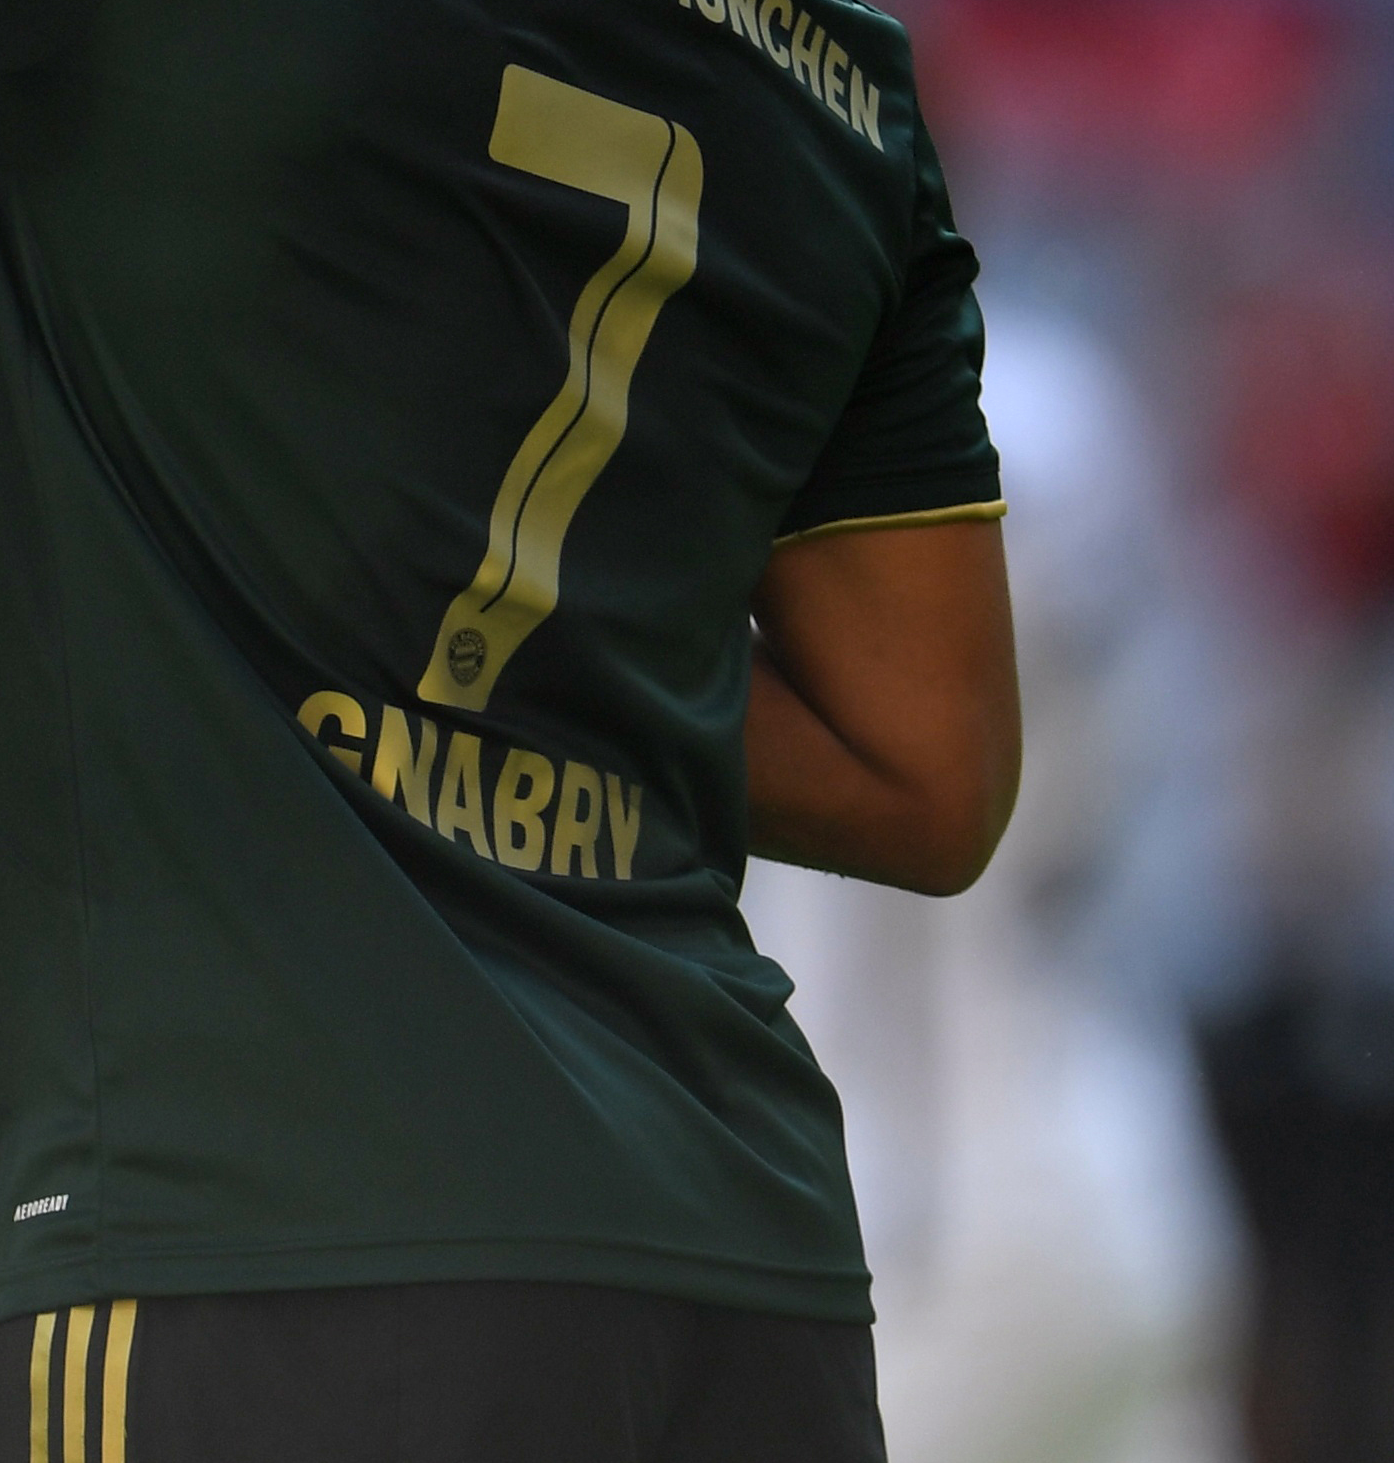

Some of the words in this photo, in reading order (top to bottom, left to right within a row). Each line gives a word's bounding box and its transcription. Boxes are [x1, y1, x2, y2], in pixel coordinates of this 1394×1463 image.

[416, 62, 705, 713] 7
[296, 689, 644, 882] GNABRY
[13, 1193, 70, 1223] AEROREADY
